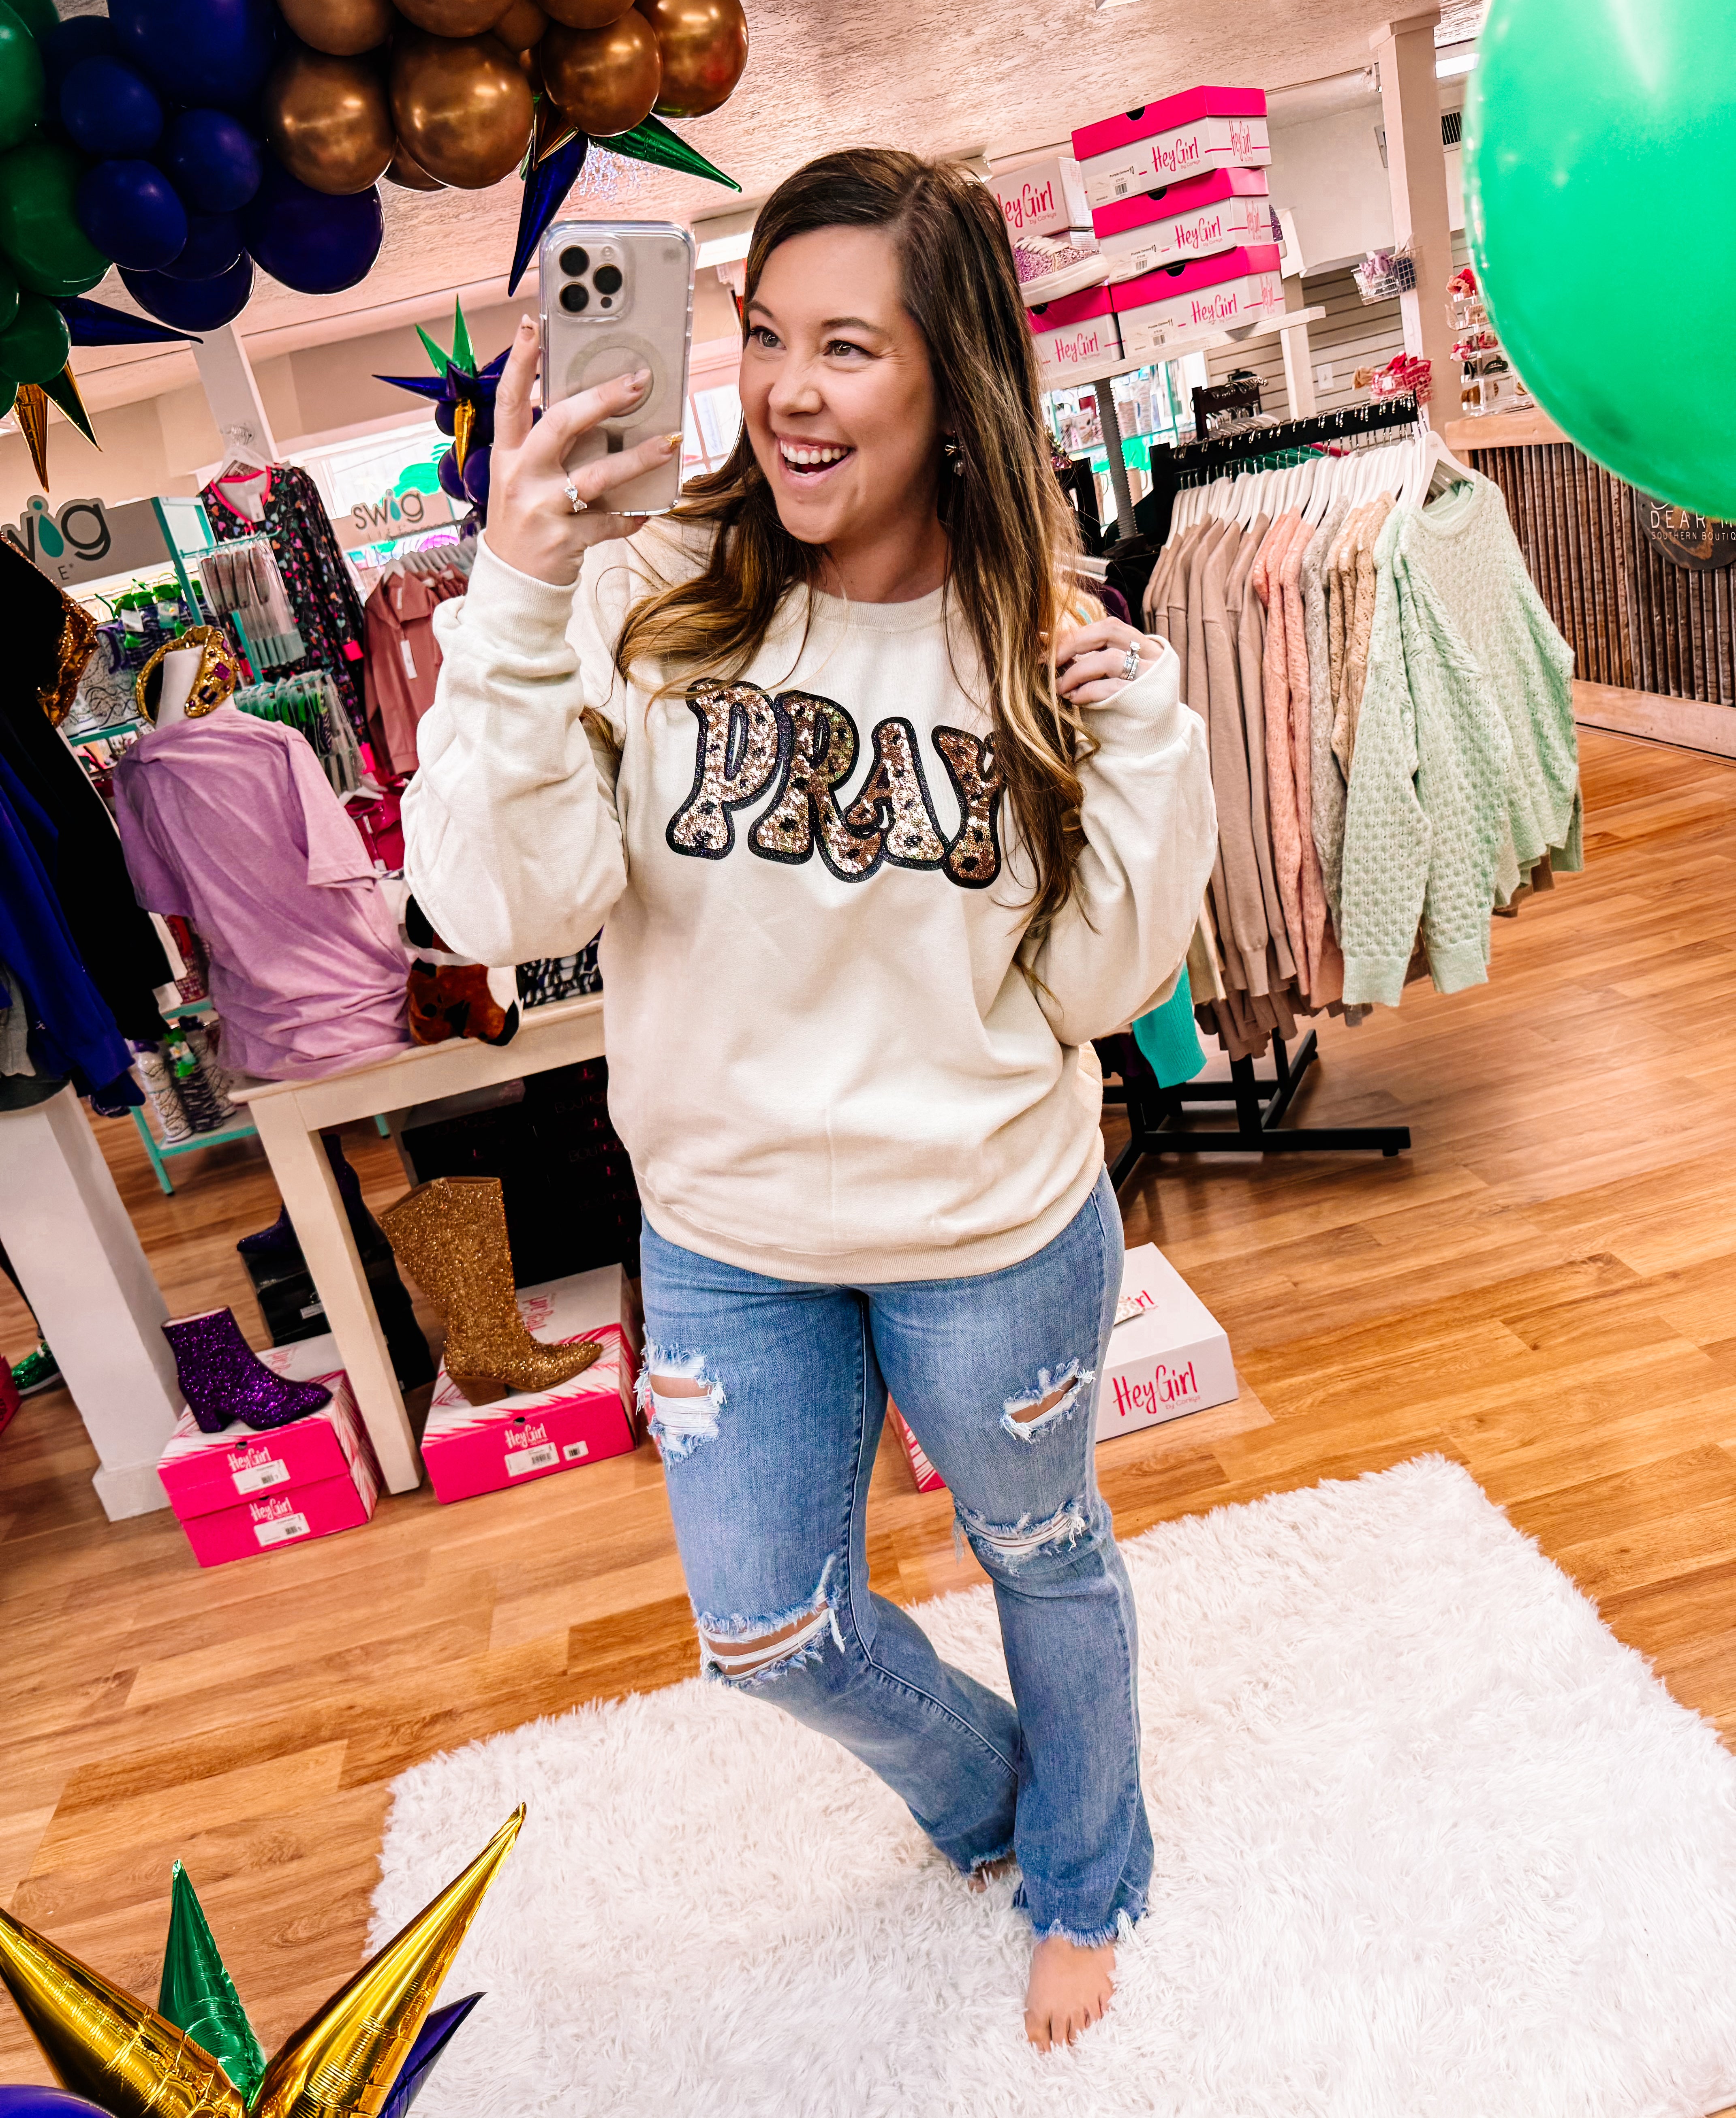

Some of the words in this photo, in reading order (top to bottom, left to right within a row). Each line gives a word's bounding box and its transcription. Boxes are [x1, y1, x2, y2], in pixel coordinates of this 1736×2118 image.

[353, 491, 424, 530] swig
[1650, 510, 1706, 528] DEAR
[1652, 532, 1697, 540] SOUTHERN
[665, 677, 1007, 889] PRAY
[1112, 1361, 1198, 1416] HeyGirl
